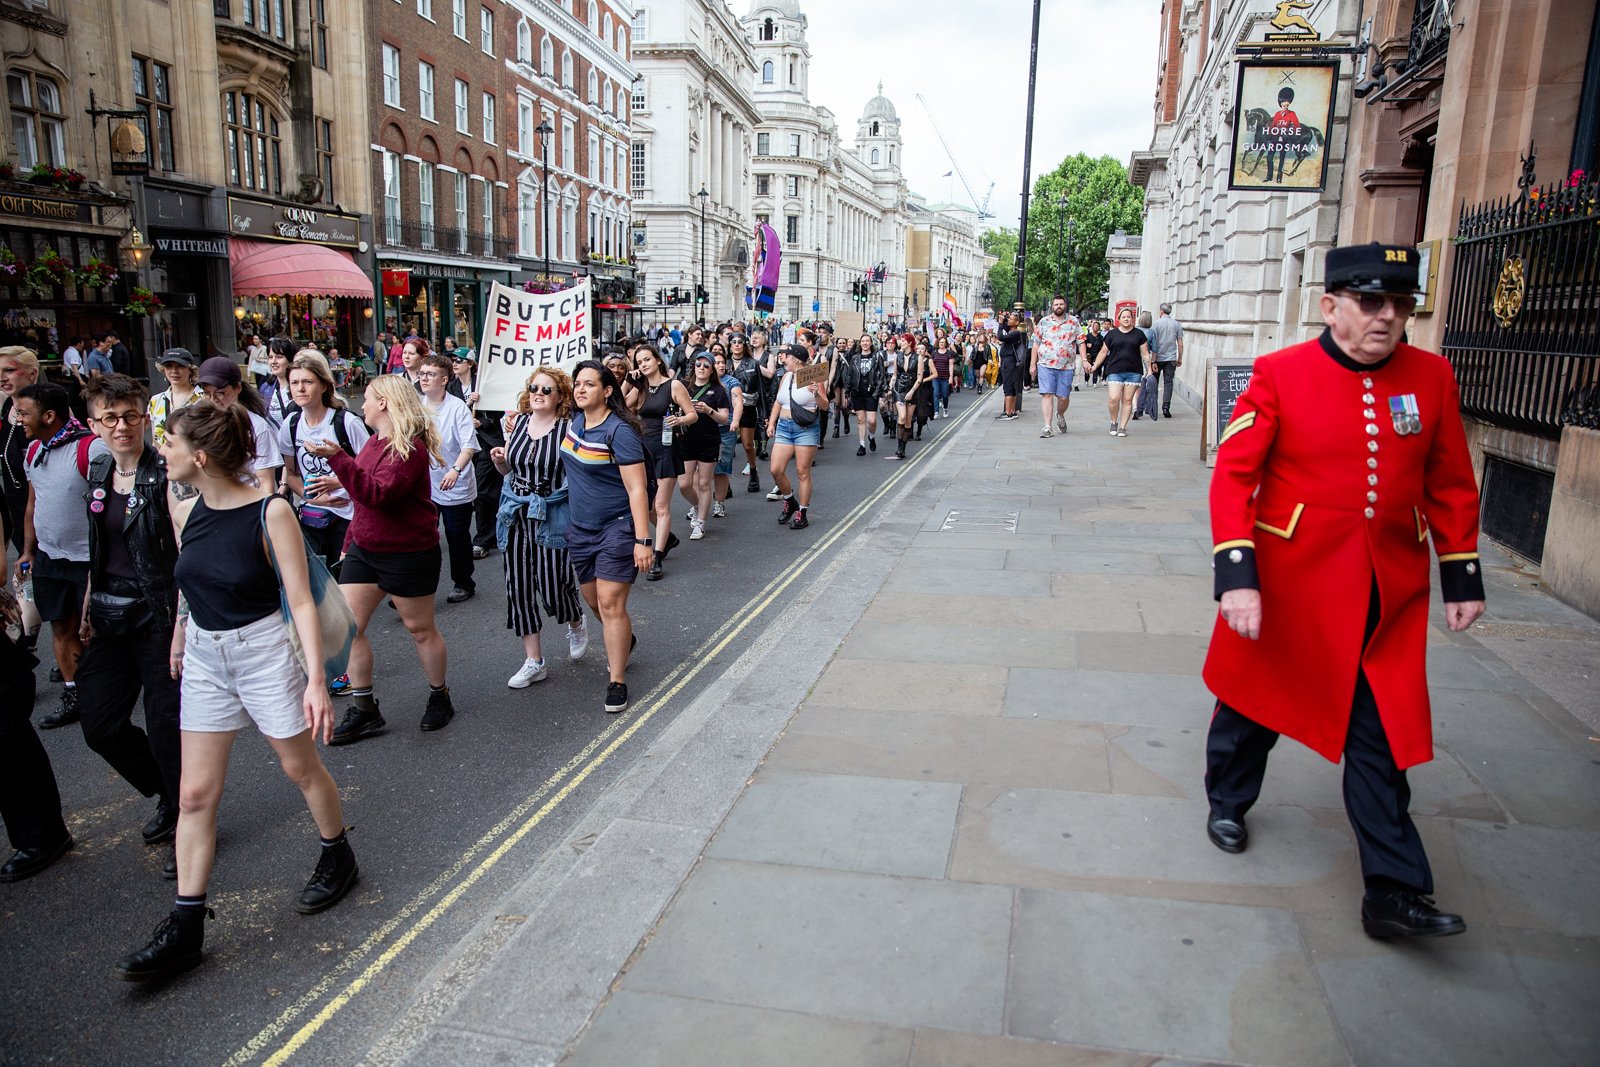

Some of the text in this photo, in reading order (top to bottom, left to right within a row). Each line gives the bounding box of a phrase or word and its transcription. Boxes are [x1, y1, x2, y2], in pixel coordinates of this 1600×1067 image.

[1262, 126, 1302, 136] HORSE
[1242, 142, 1319, 152] GUARDSMAN
[1, 195, 78, 219] Old Shades
[1385, 249, 1408, 262] RH
[412, 264, 427, 276] GIFT
[430, 265, 442, 277] BOX
[187, 295, 197, 307] 41
[496, 290, 586, 321] BUTCH
[495, 312, 586, 343] FEMME
[488, 335, 587, 367] FOREVER
